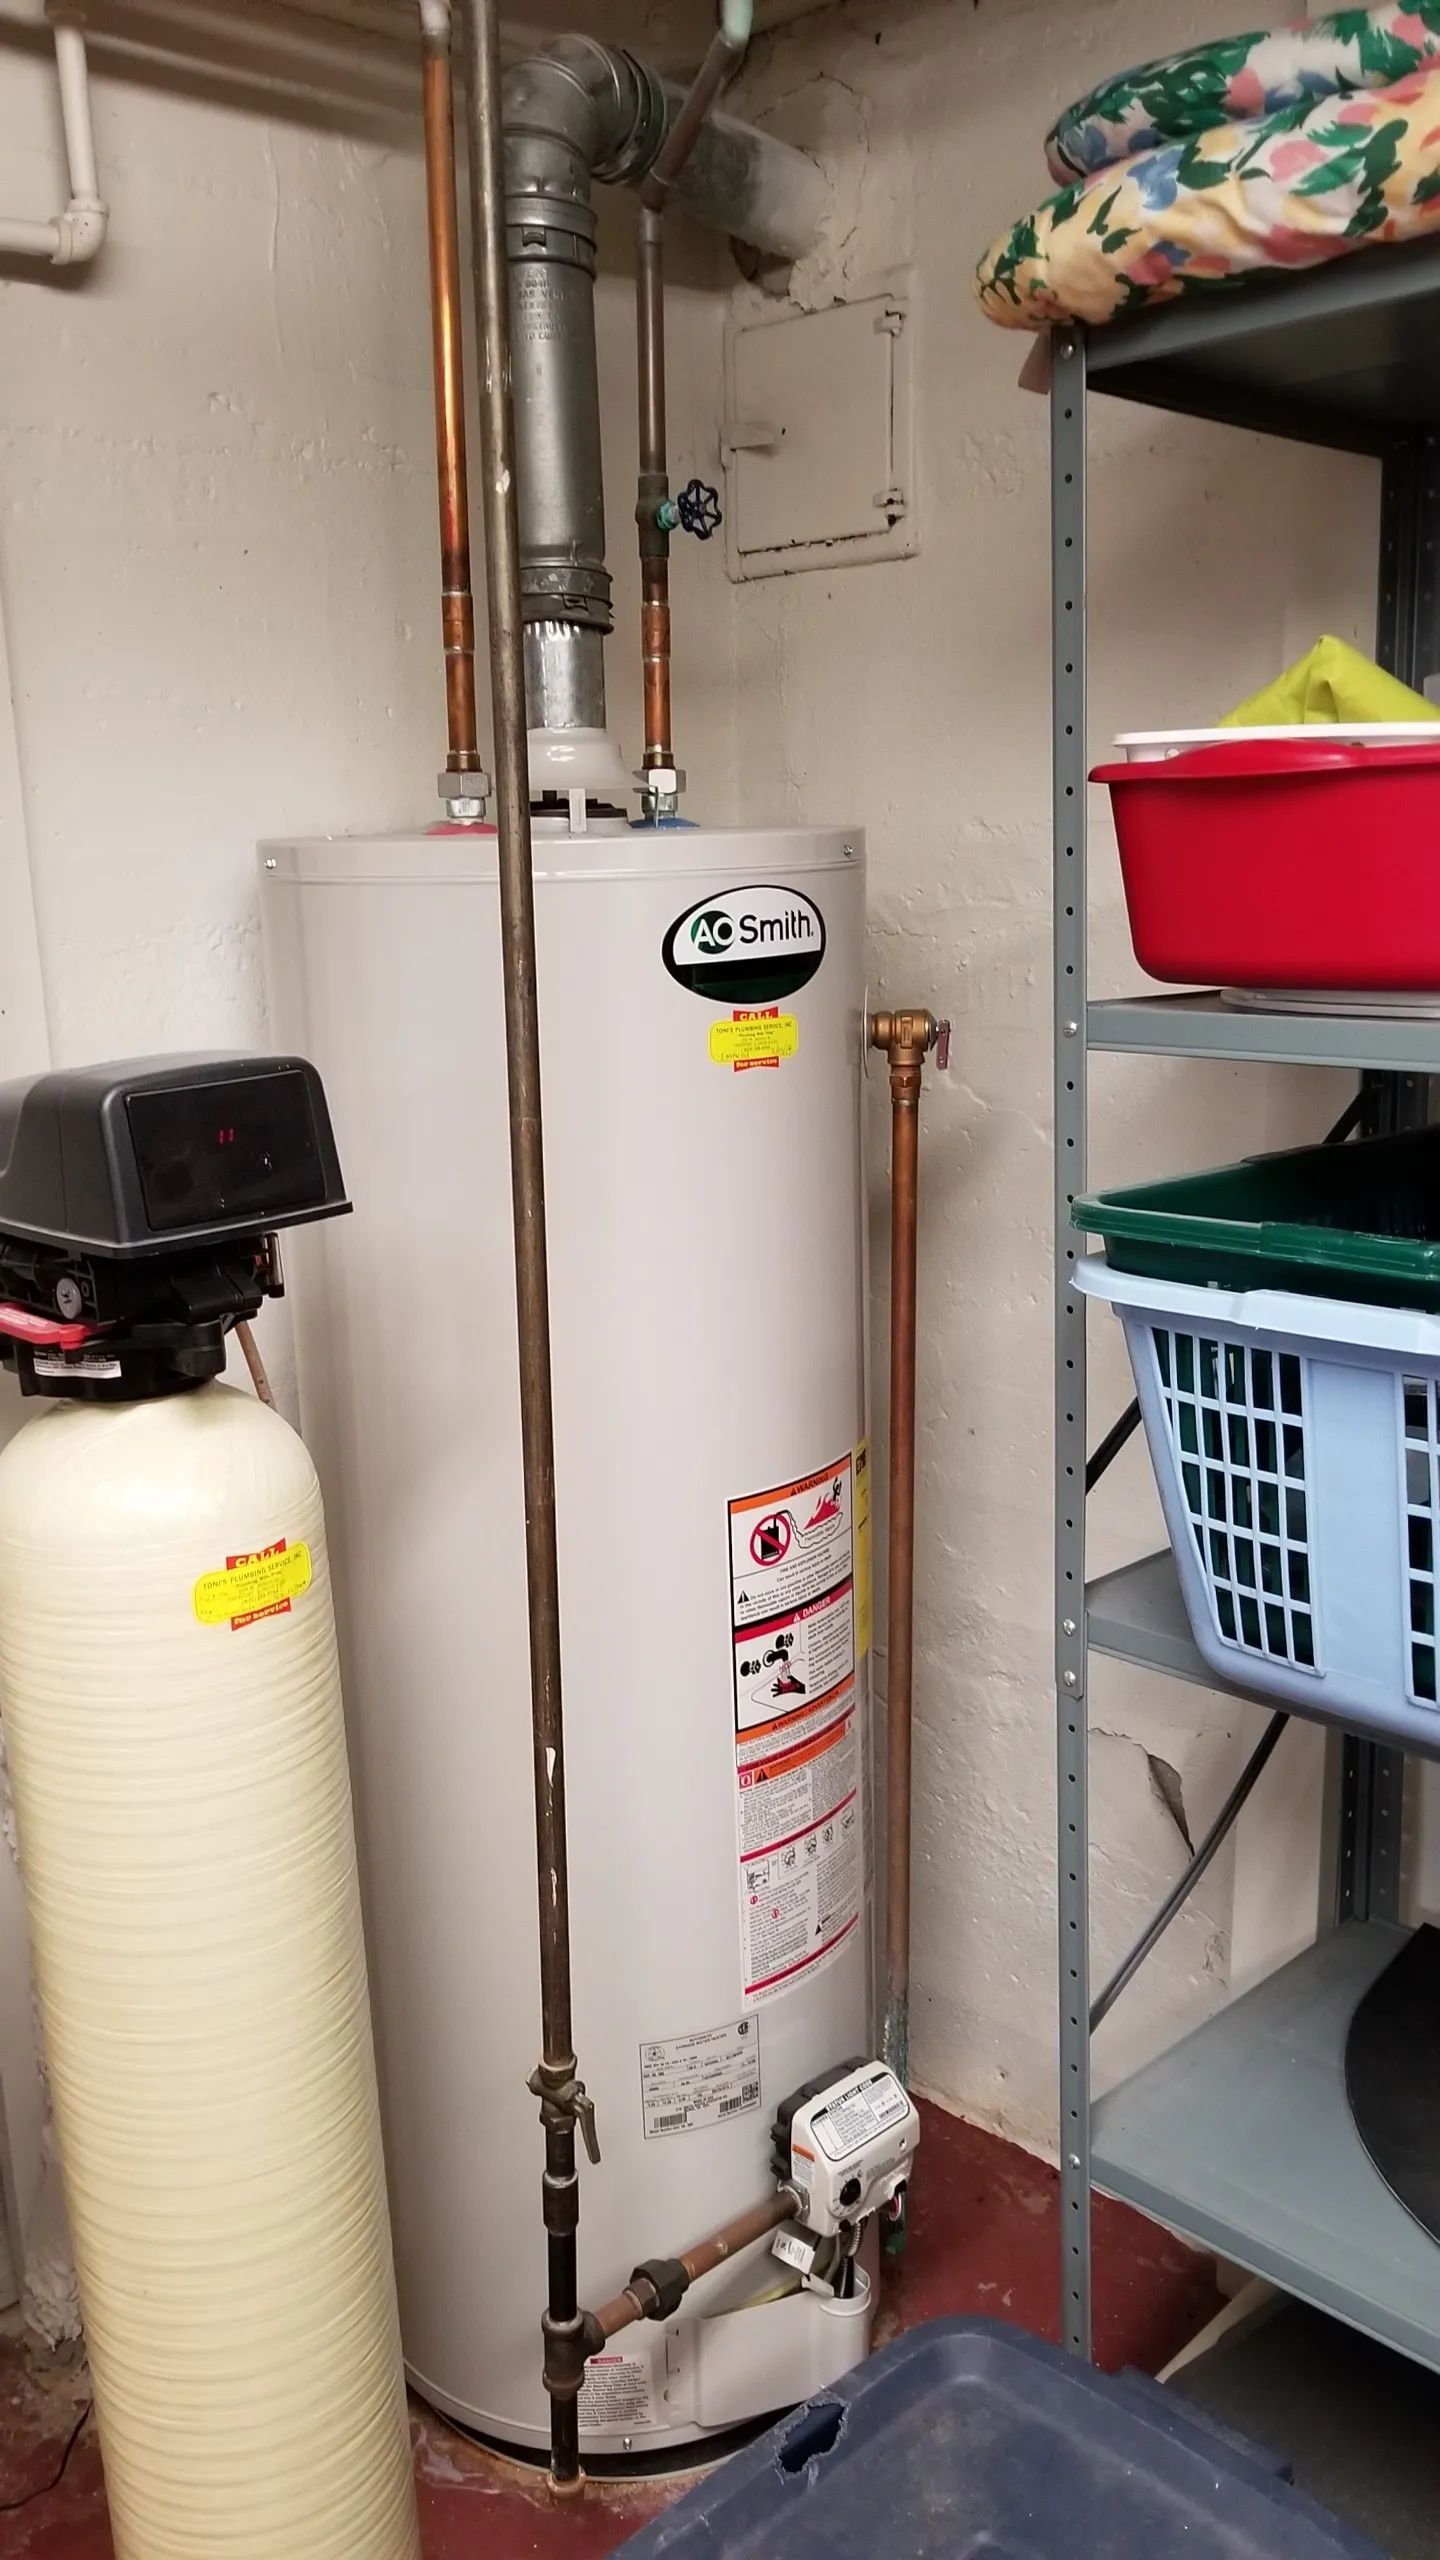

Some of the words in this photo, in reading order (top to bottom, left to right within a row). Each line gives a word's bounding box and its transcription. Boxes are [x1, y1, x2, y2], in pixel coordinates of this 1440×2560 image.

[691, 912, 735, 952] AO
[740, 909, 811, 945] Smith
[740, 1011, 775, 1021] CALL
[735, 1024, 761, 1032] PLUMBING
[796, 1472, 829, 1494] WARNING
[235, 1548, 280, 1567] CALL
[203, 1579, 227, 1590] TONI'S
[230, 1567, 267, 1584] PLUMBING
[802, 1596, 831, 1618] DANGER
